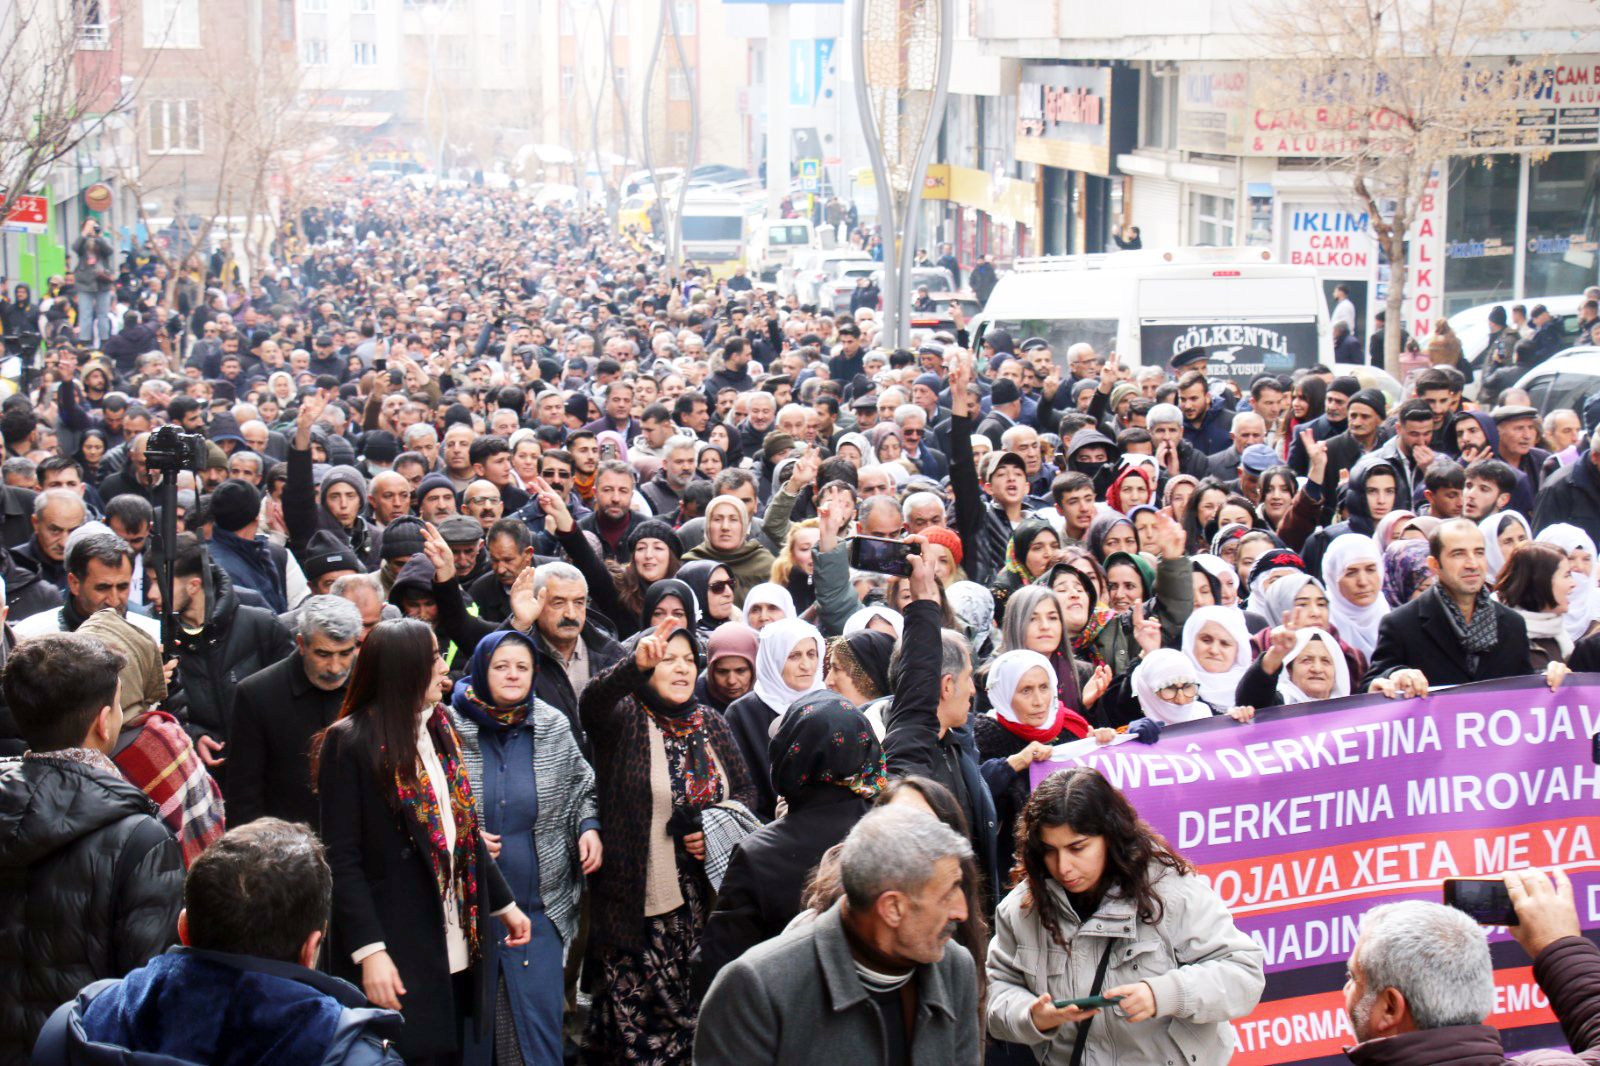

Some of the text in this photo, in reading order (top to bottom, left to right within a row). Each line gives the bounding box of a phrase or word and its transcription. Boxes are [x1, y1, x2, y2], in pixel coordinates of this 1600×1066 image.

[1556, 66, 1589, 85] CAM
[1569, 87, 1600, 104] ALÜ
[1292, 251, 1367, 267] BALKON
[1310, 235, 1349, 249] CAM
[1415, 194, 1435, 338] BALKON
[1215, 715, 1442, 779] DERKETINA
[1178, 764, 1600, 849] DERKETINA MIROVAH
[1351, 840, 1461, 888] XETA
[1473, 832, 1531, 875] ME
[1542, 824, 1595, 865] YA
